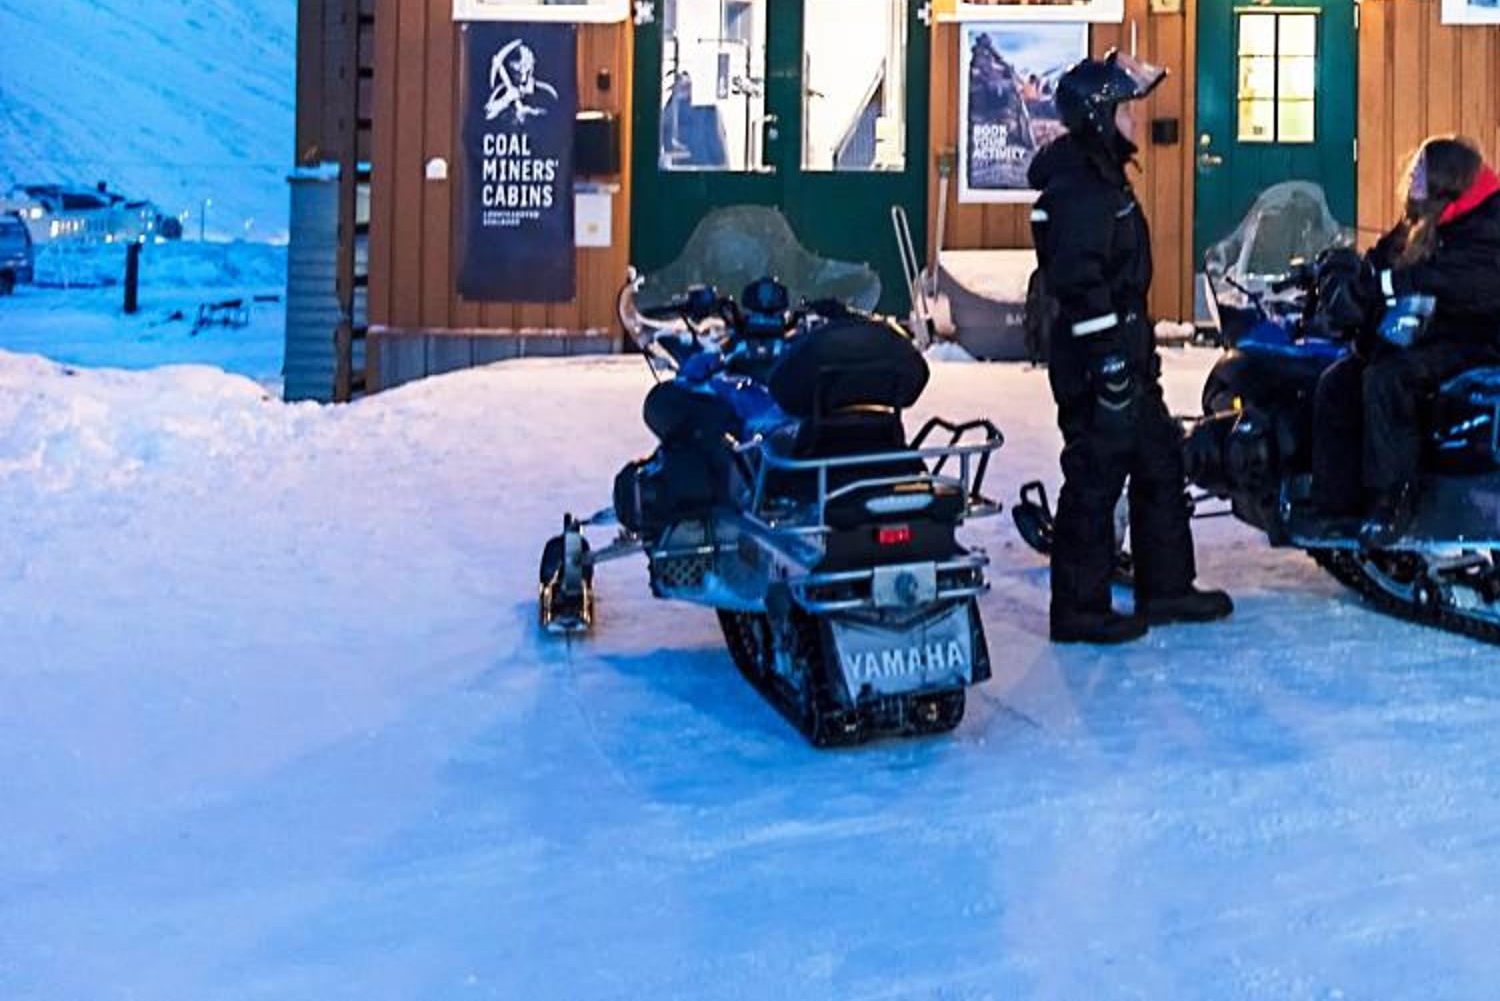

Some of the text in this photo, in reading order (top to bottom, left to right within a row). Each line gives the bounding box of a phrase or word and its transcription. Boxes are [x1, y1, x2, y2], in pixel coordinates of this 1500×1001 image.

[483, 133, 531, 156] COAL
[483, 159, 559, 181] MINERS'
[483, 185, 553, 207] CABINS
[846, 641, 965, 681] YAMAHA
